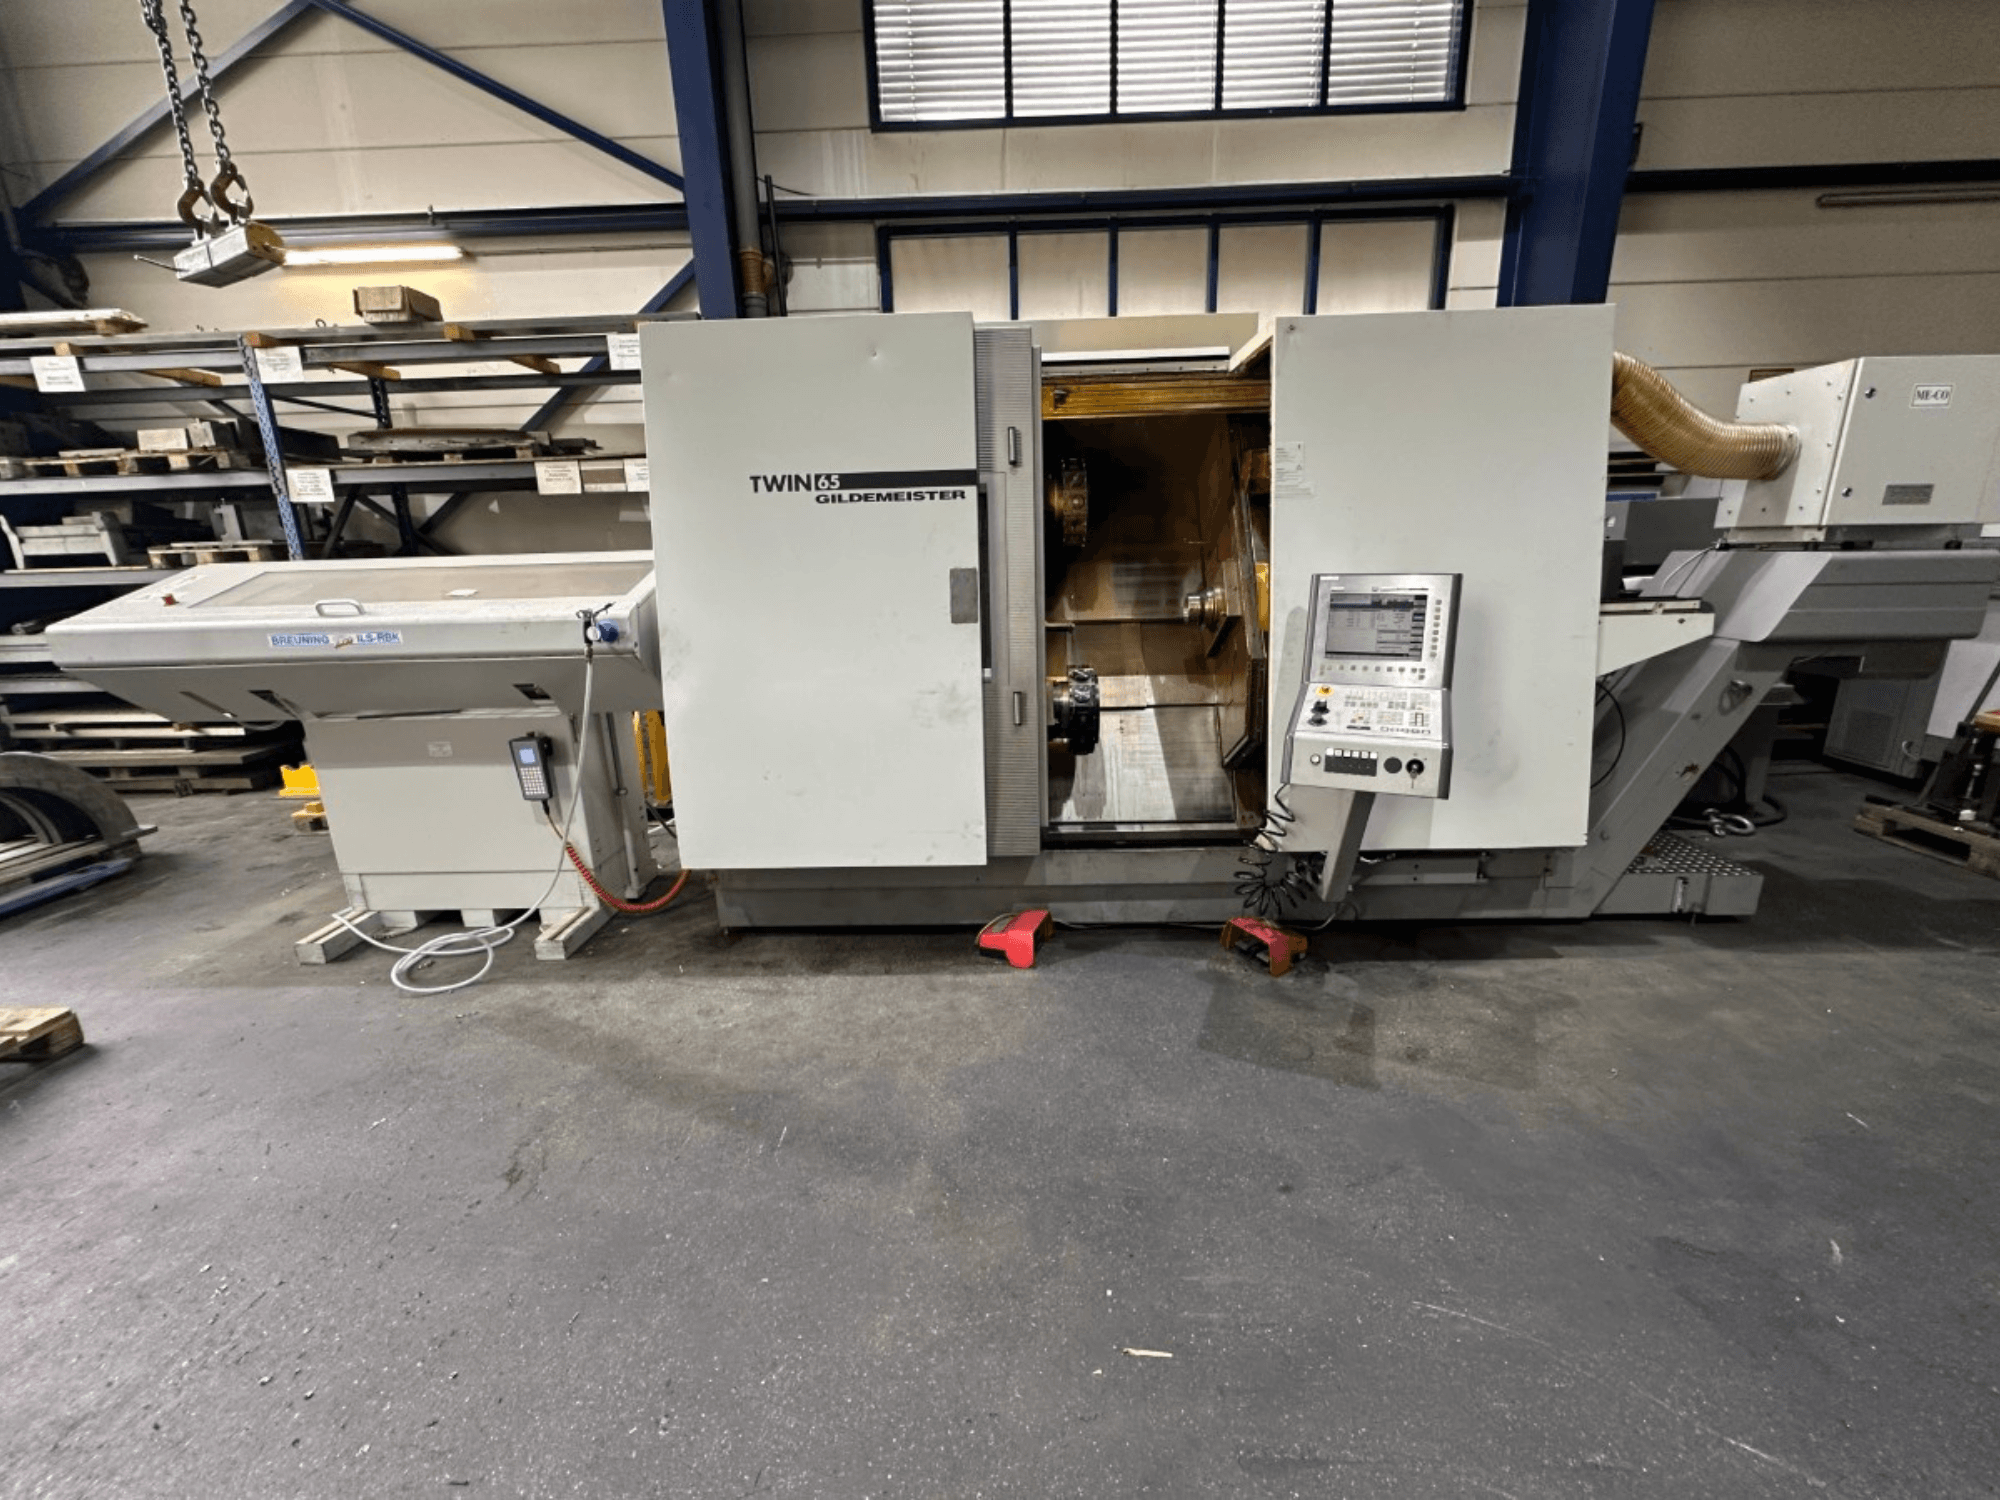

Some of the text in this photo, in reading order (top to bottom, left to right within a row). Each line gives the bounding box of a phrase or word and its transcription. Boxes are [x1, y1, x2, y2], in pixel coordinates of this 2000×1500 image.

[750, 474, 840, 493] TWIN 65
[815, 490, 966, 504] GILDEMEISTER
[271, 633, 330, 646] BREUNING
